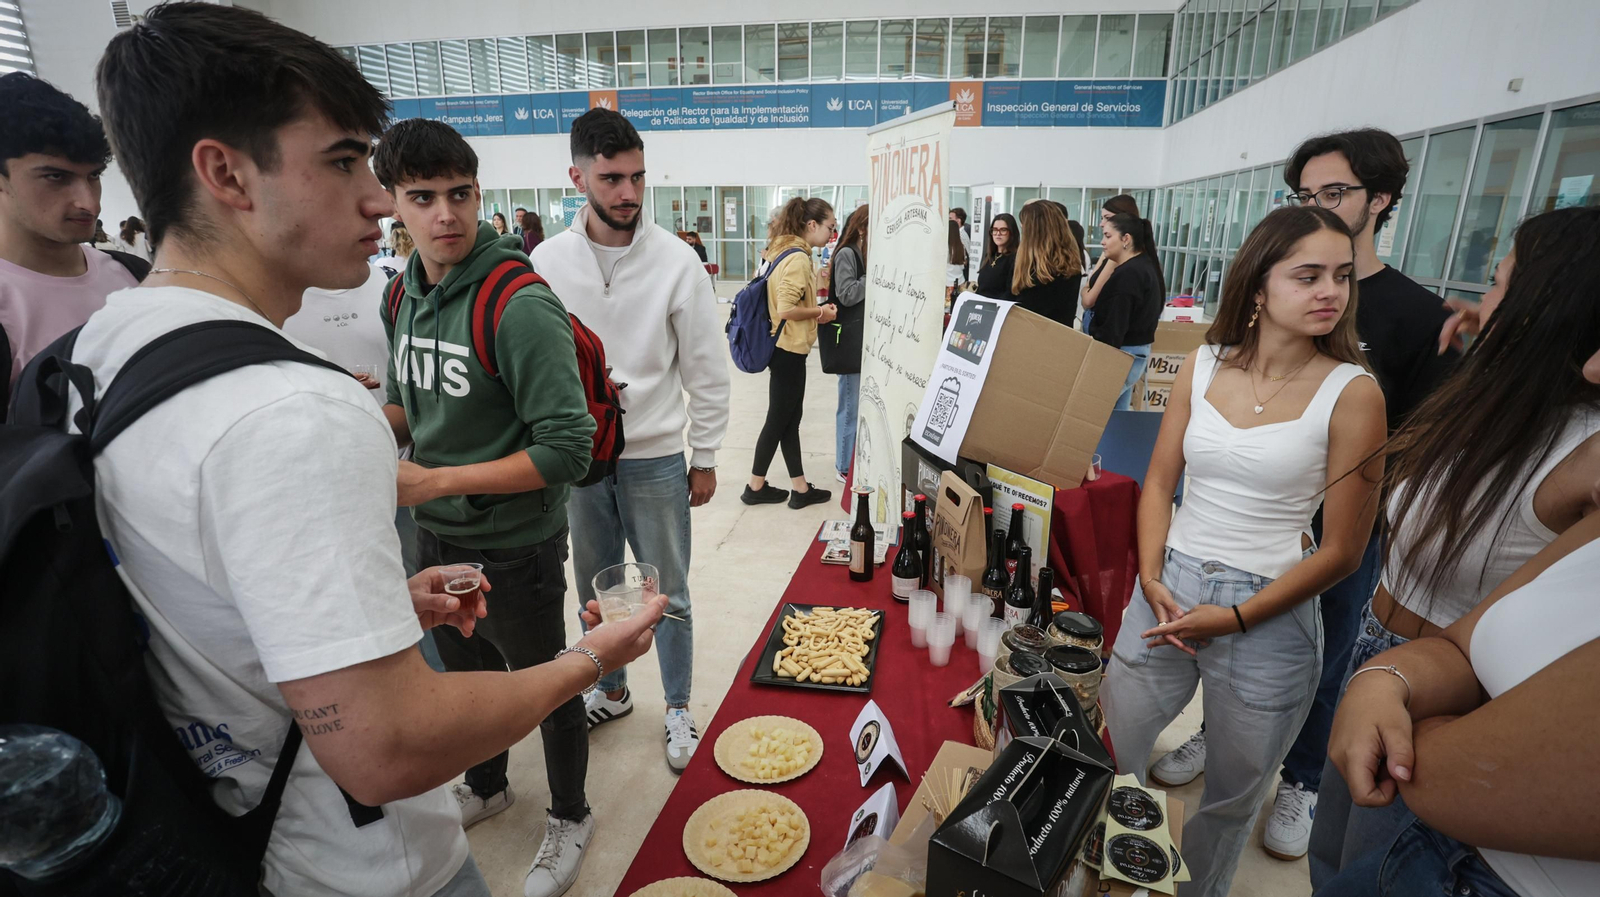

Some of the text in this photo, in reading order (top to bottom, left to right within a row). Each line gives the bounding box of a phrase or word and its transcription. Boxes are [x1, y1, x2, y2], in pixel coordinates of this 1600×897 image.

[620, 104, 809, 118] Delegación del Rector para la Implementación
[848, 99, 873, 110] UCA
[987, 102, 1141, 113] Inspección General de Servicios
[442, 115, 471, 124] Campus
[484, 114, 503, 122] Jerez
[532, 108, 554, 119] UCA
[651, 117, 661, 125] de
[699, 116, 710, 124] de
[712, 114, 748, 125] Igualdad
[750, 116, 755, 125] y
[757, 115, 768, 123] de
[770, 113, 809, 123] Inclusión
[394, 333, 471, 398] VANS
[1003, 485, 1011, 495] TE
[1011, 489, 1048, 508] OFRECEMOS?
[304, 703, 339, 720] CAN'T
[311, 719, 345, 736] LOVE
[175, 721, 233, 751] ans
[224, 754, 247, 767] Fresh
[1003, 751, 1036, 785] Producto
[1048, 798, 1069, 823] 100%
[1064, 767, 1086, 800] natural
